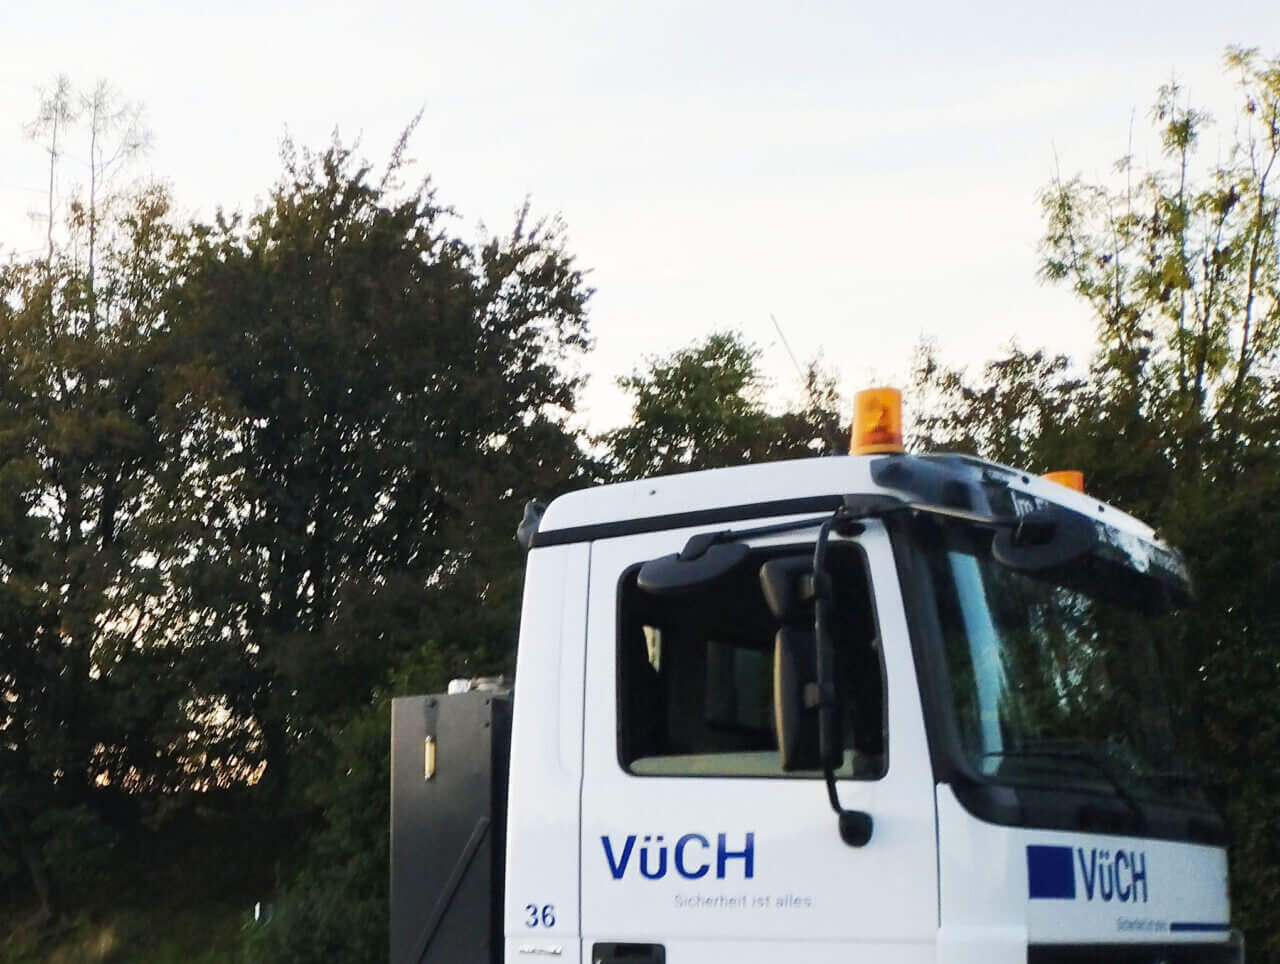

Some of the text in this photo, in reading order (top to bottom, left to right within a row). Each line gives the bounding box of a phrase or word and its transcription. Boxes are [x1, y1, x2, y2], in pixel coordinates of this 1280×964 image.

[600, 832, 755, 880] VüCH
[1078, 848, 1148, 902] VüCH
[525, 903, 556, 929] 36
[673, 892, 813, 909] Sicherheit ist alles
